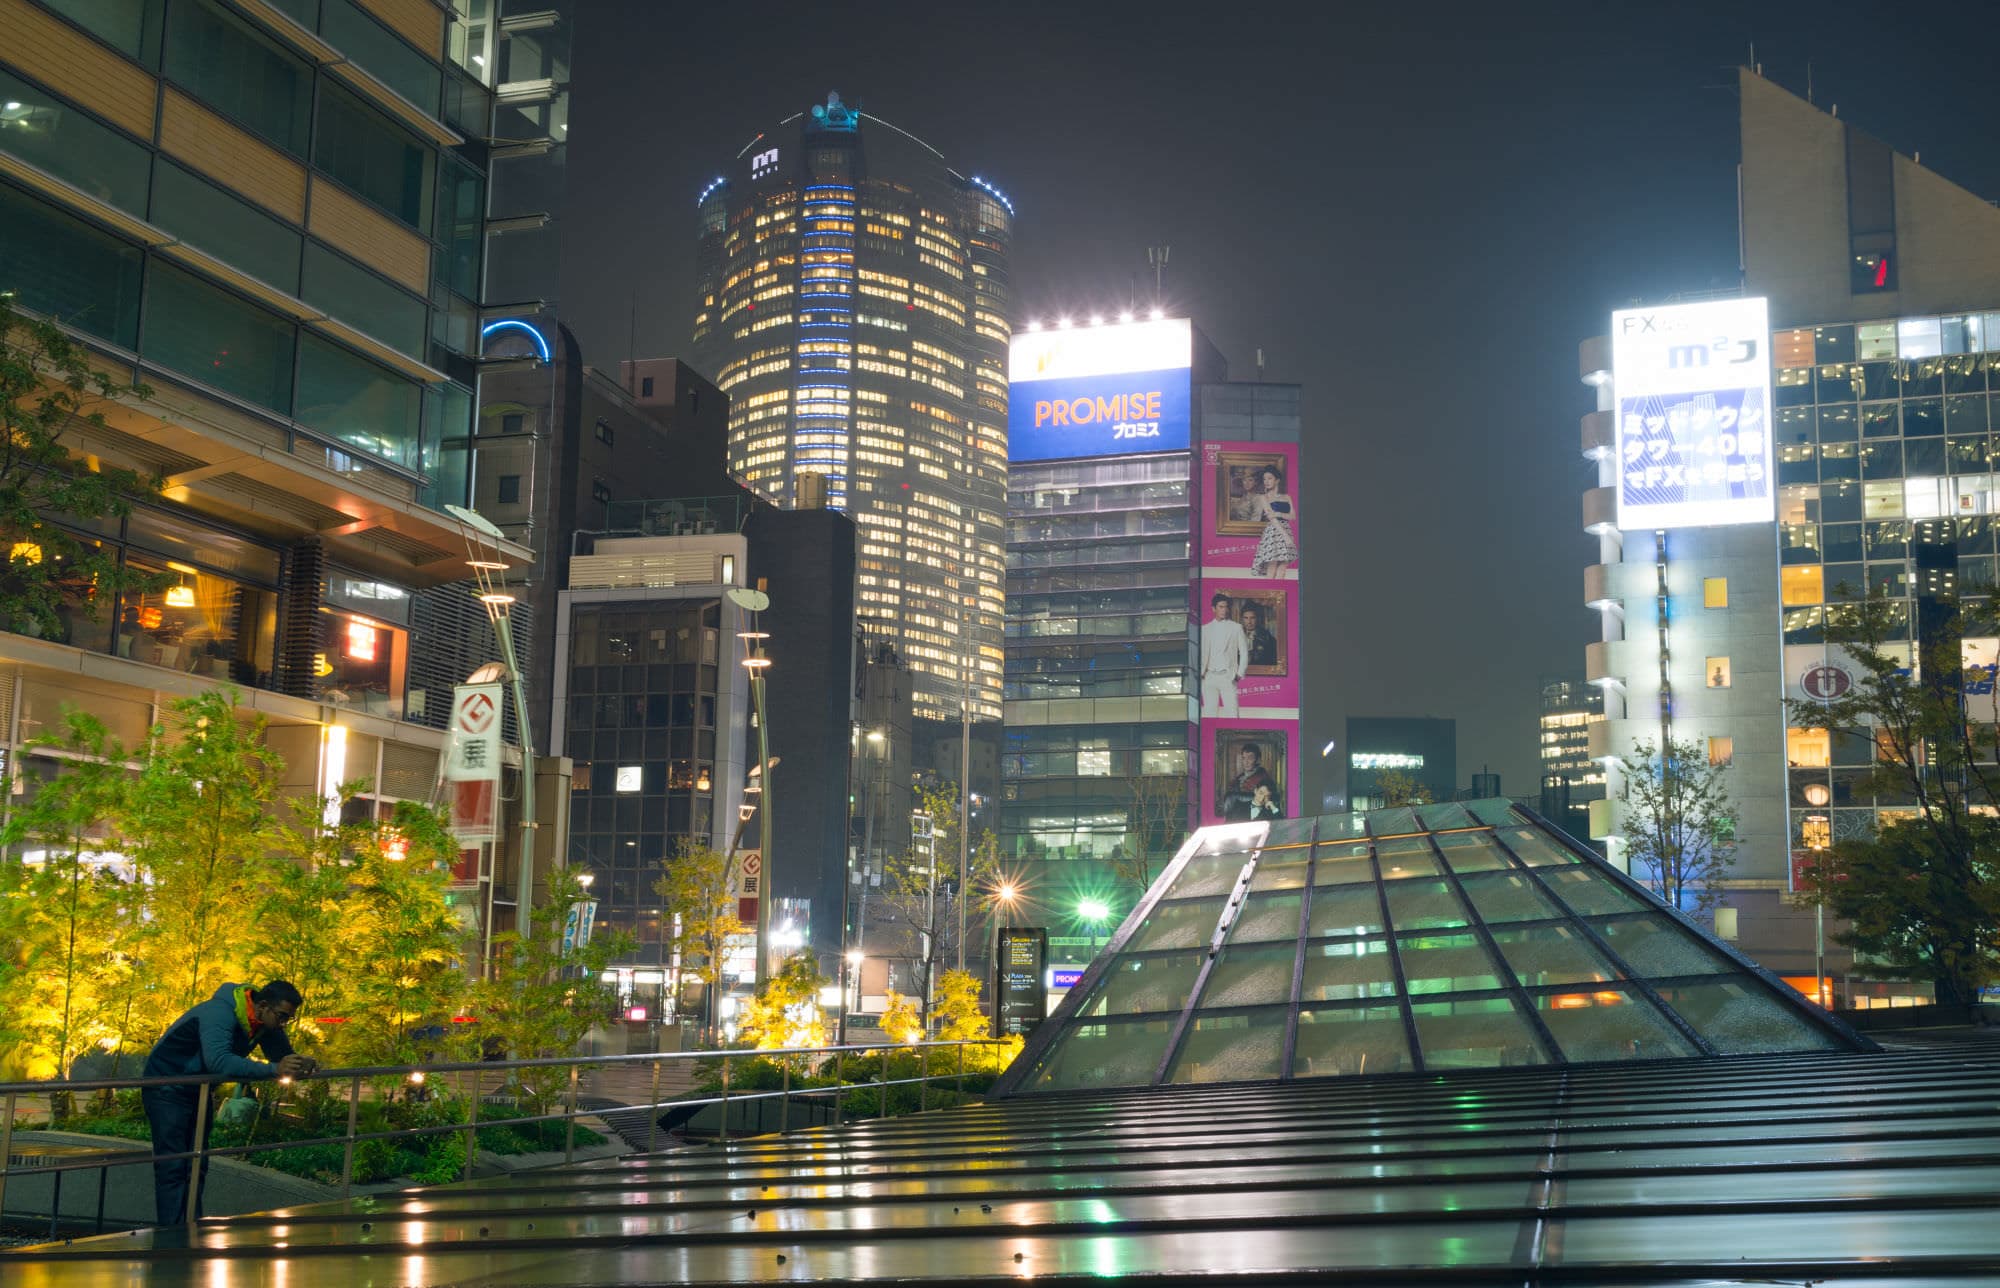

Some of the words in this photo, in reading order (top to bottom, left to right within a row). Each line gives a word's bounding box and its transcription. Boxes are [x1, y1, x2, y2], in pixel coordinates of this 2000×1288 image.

[1035, 391, 1162, 428] PROMISE
[1112, 422, 1160, 440] プロミス
[744, 877, 758, 893] 展
